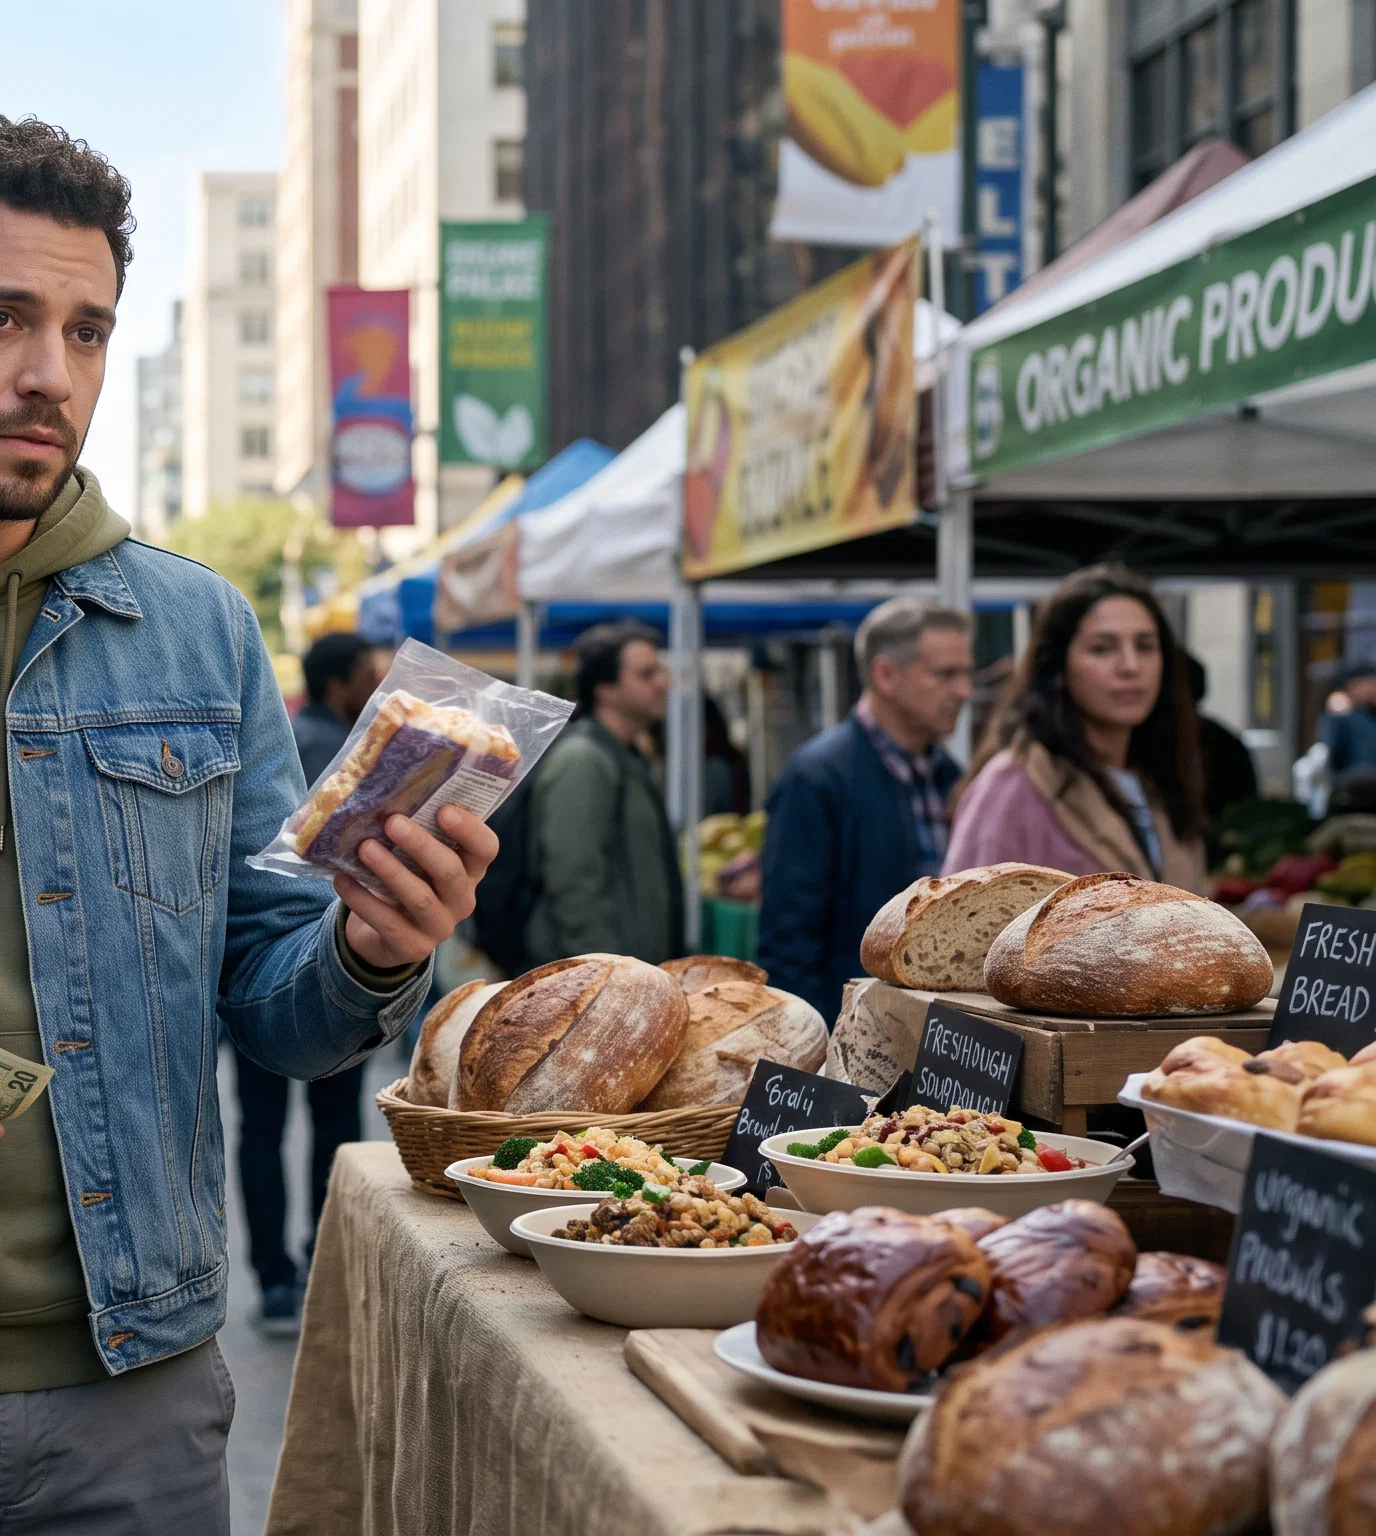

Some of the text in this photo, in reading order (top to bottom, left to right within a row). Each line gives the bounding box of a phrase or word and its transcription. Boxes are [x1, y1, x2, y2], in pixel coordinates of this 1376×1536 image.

[1016, 295, 1193, 433] ORGANIC
[1199, 219, 1376, 374] PRODU
[1299, 921, 1376, 967] FRESH
[1289, 975, 1370, 1023] BREAD
[7, 1070, 39, 1094] 20
